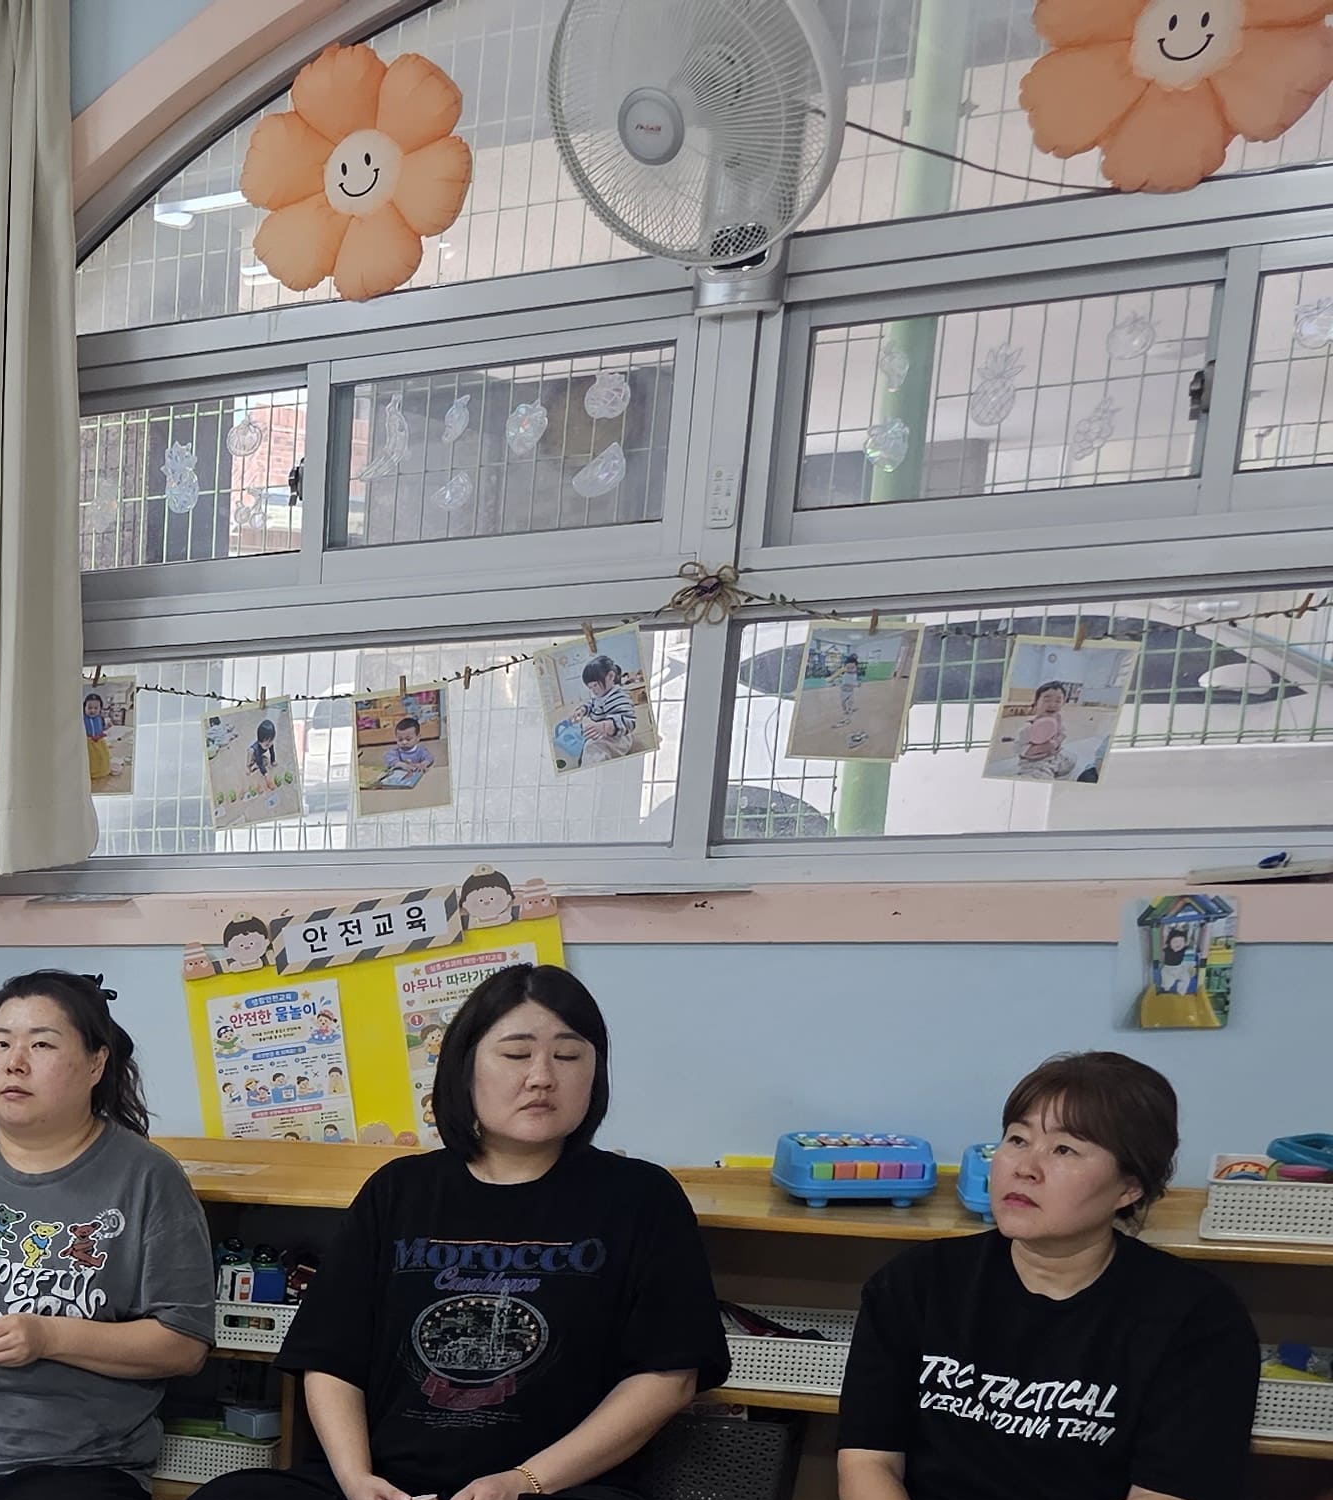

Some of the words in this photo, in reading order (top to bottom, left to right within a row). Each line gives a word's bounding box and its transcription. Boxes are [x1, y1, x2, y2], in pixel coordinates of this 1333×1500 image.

[302, 906, 427, 954] 안전교육
[402, 975, 443, 994] 아무나
[446, 967, 495, 987] 따라가지
[229, 1009, 271, 1029] 안전한
[275, 1002, 317, 1023] 물놀이
[919, 1354, 975, 1389] TRC
[978, 1373, 1118, 1418] TACTICAL
[919, 1391, 1051, 1439] VERLADING
[1058, 1417, 1116, 1447] TEAM
